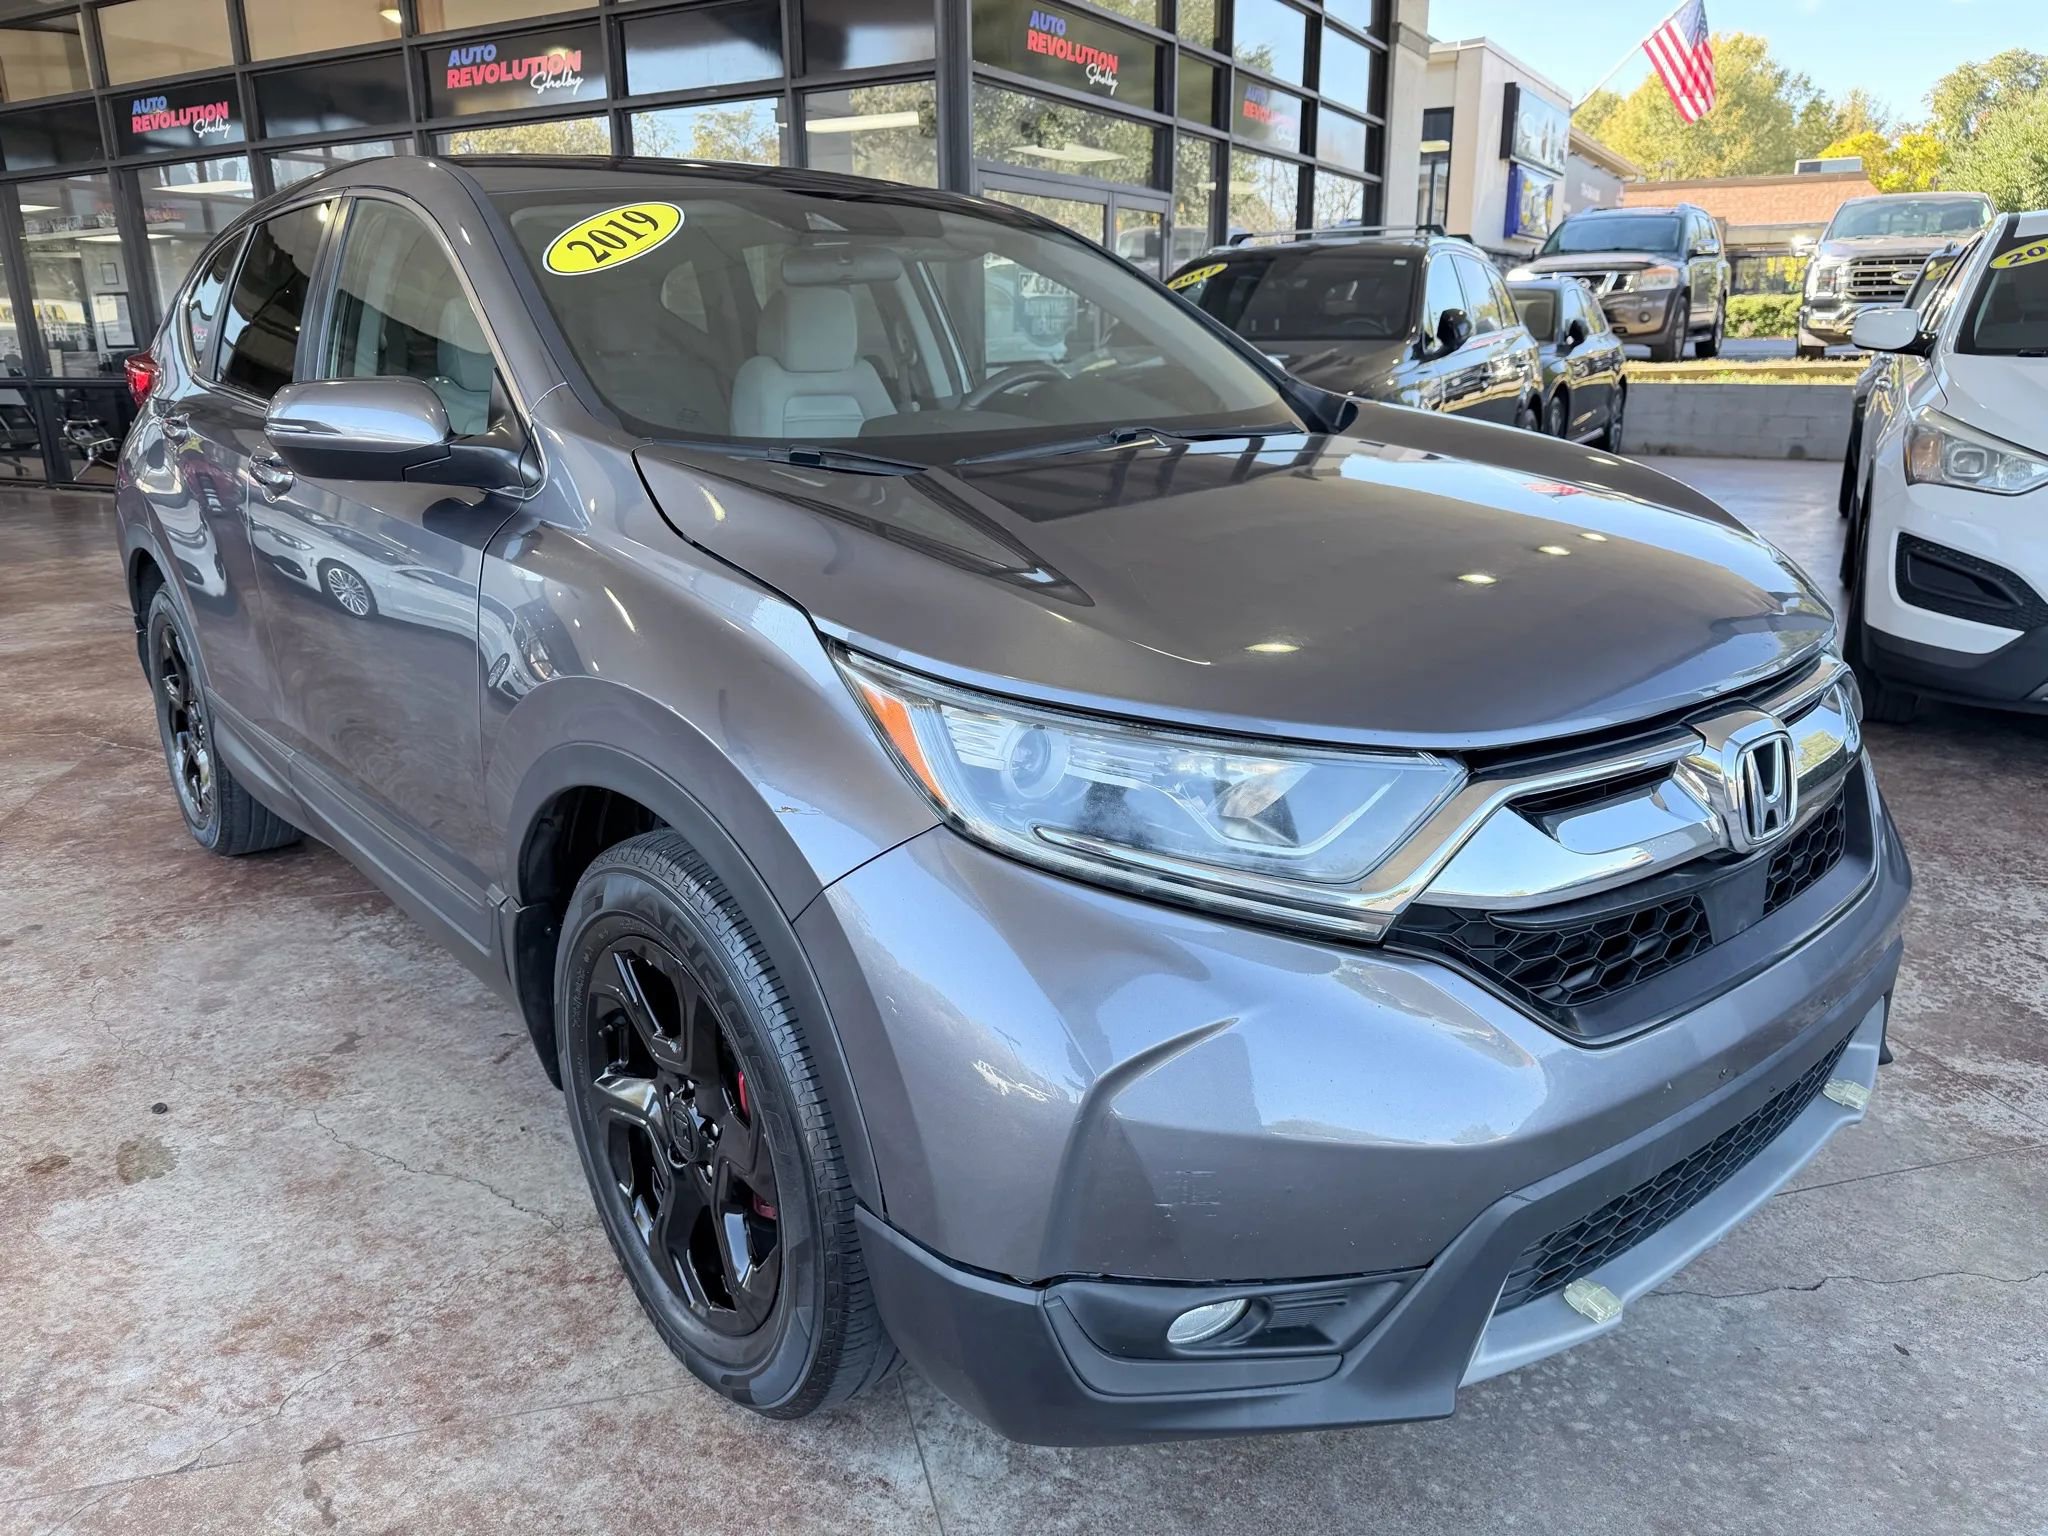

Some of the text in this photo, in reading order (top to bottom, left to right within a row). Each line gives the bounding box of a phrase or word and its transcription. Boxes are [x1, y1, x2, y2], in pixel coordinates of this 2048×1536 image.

[1029, 10, 1066, 36] AUTO
[448, 44, 497, 67] AUTO
[1027, 30, 1118, 74] REVOLUTION
[447, 50, 582, 89] REVOLUTION
[530, 70, 584, 95] Shelby
[1086, 63, 1119, 96] Shelby
[132, 96, 167, 115] AUTO
[132, 101, 229, 134] REVOLUTION
[193, 115, 231, 138] Shelby
[567, 211, 659, 263] 2019
[2005, 244, 2048, 266] 20
